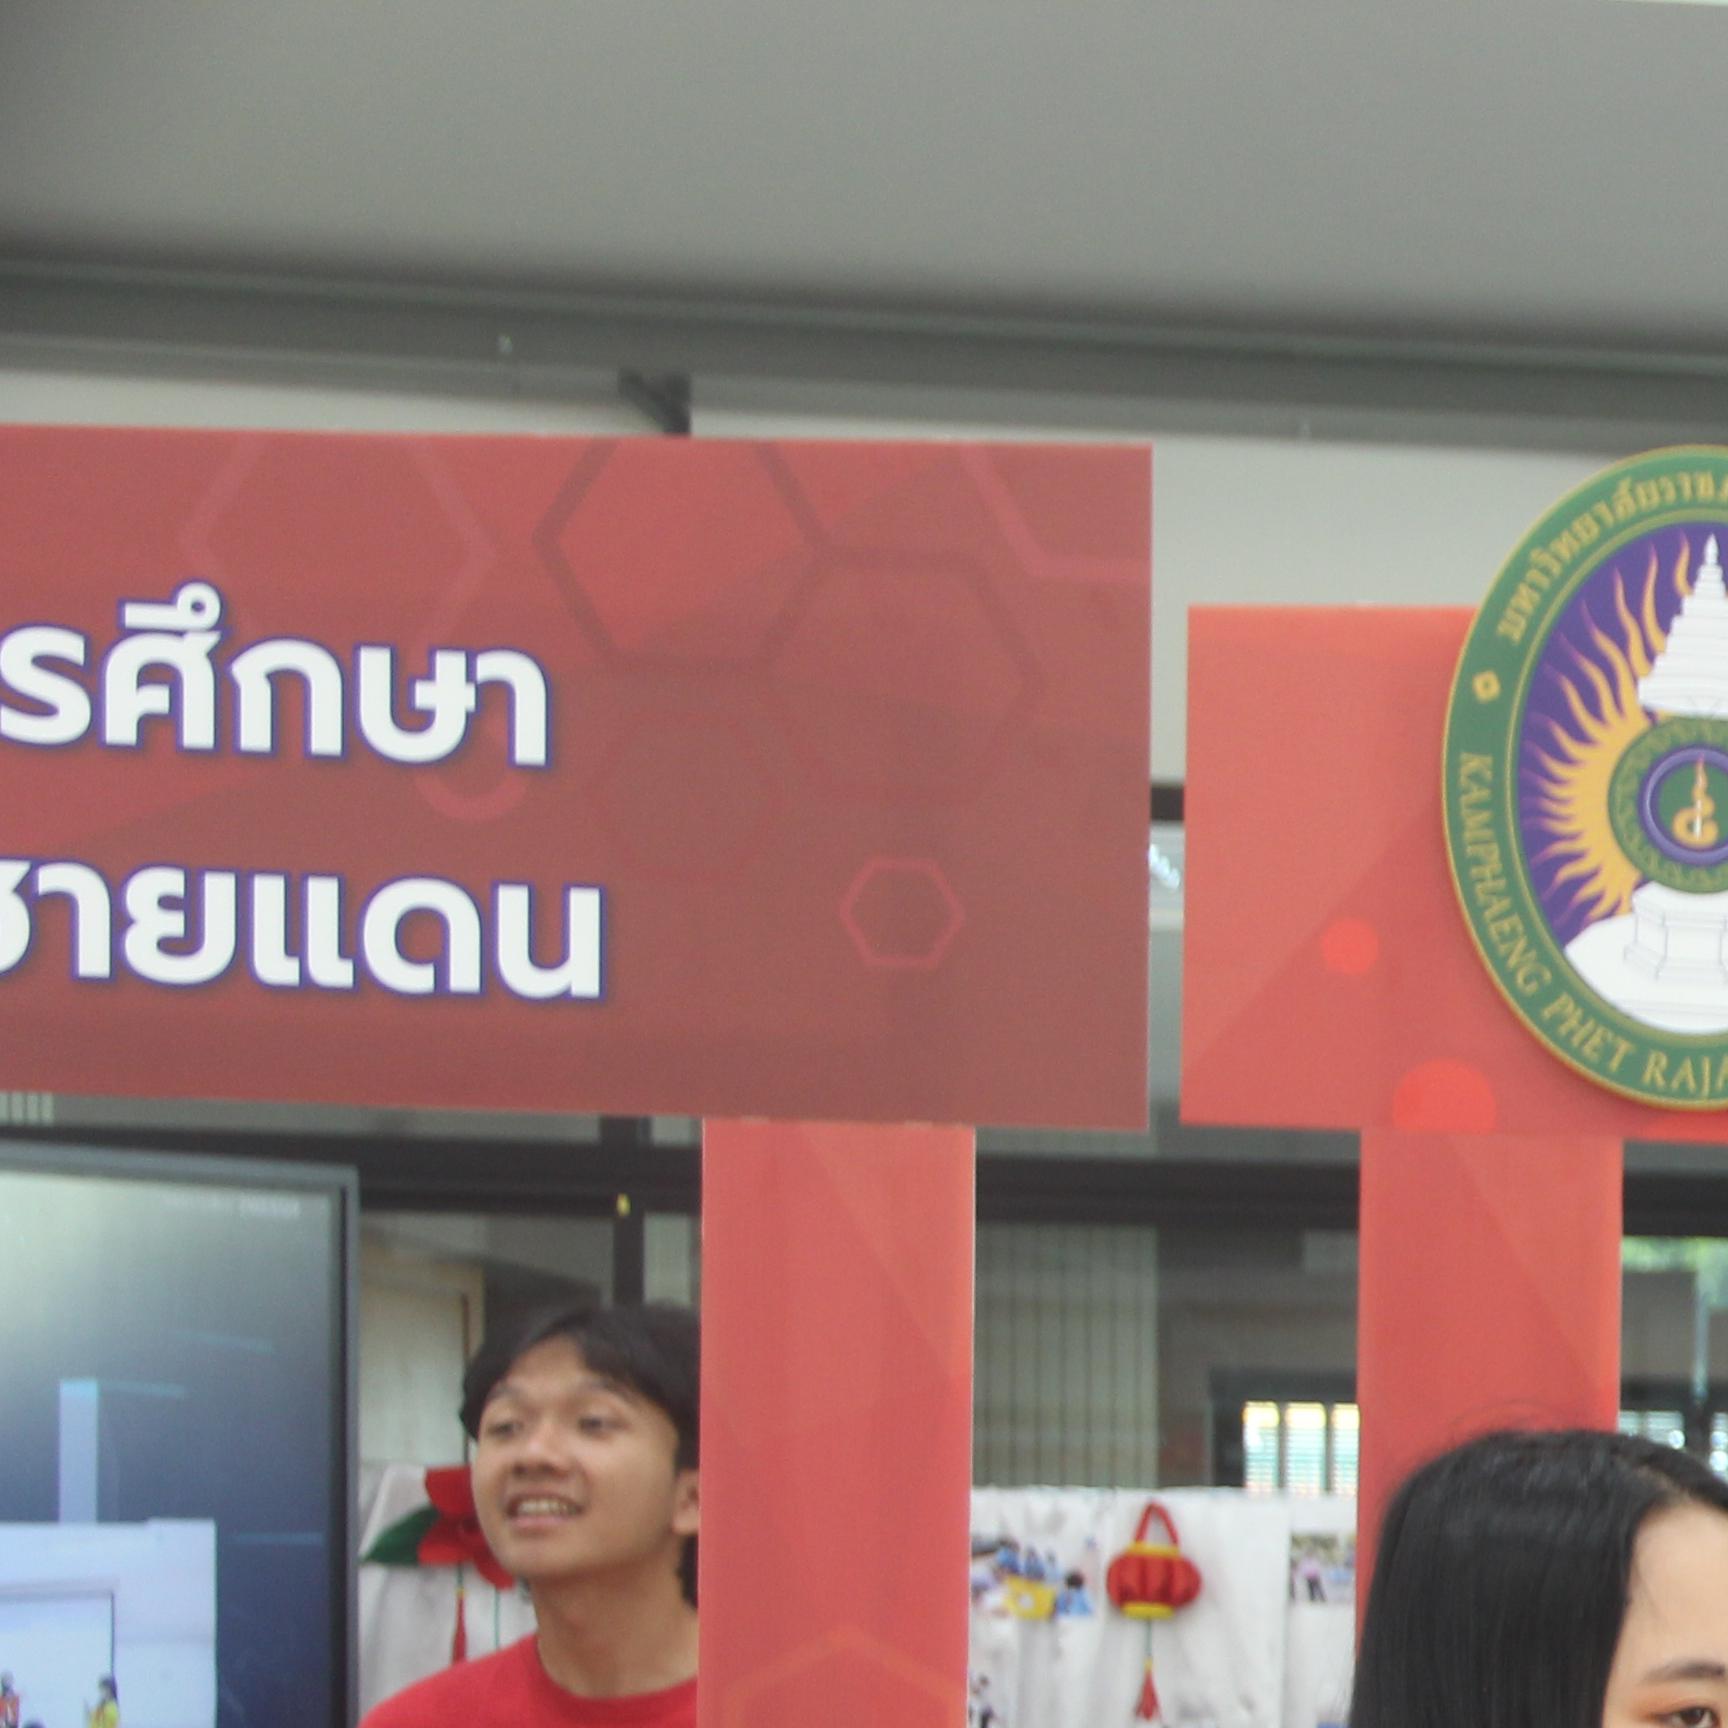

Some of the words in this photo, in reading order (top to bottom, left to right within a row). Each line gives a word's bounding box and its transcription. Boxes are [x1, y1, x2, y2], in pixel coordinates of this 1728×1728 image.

[0, 580, 548, 766] รศึกษา
[1459, 751, 1552, 995] KAMPHAENG
[1541, 992, 1637, 1076] PHET
